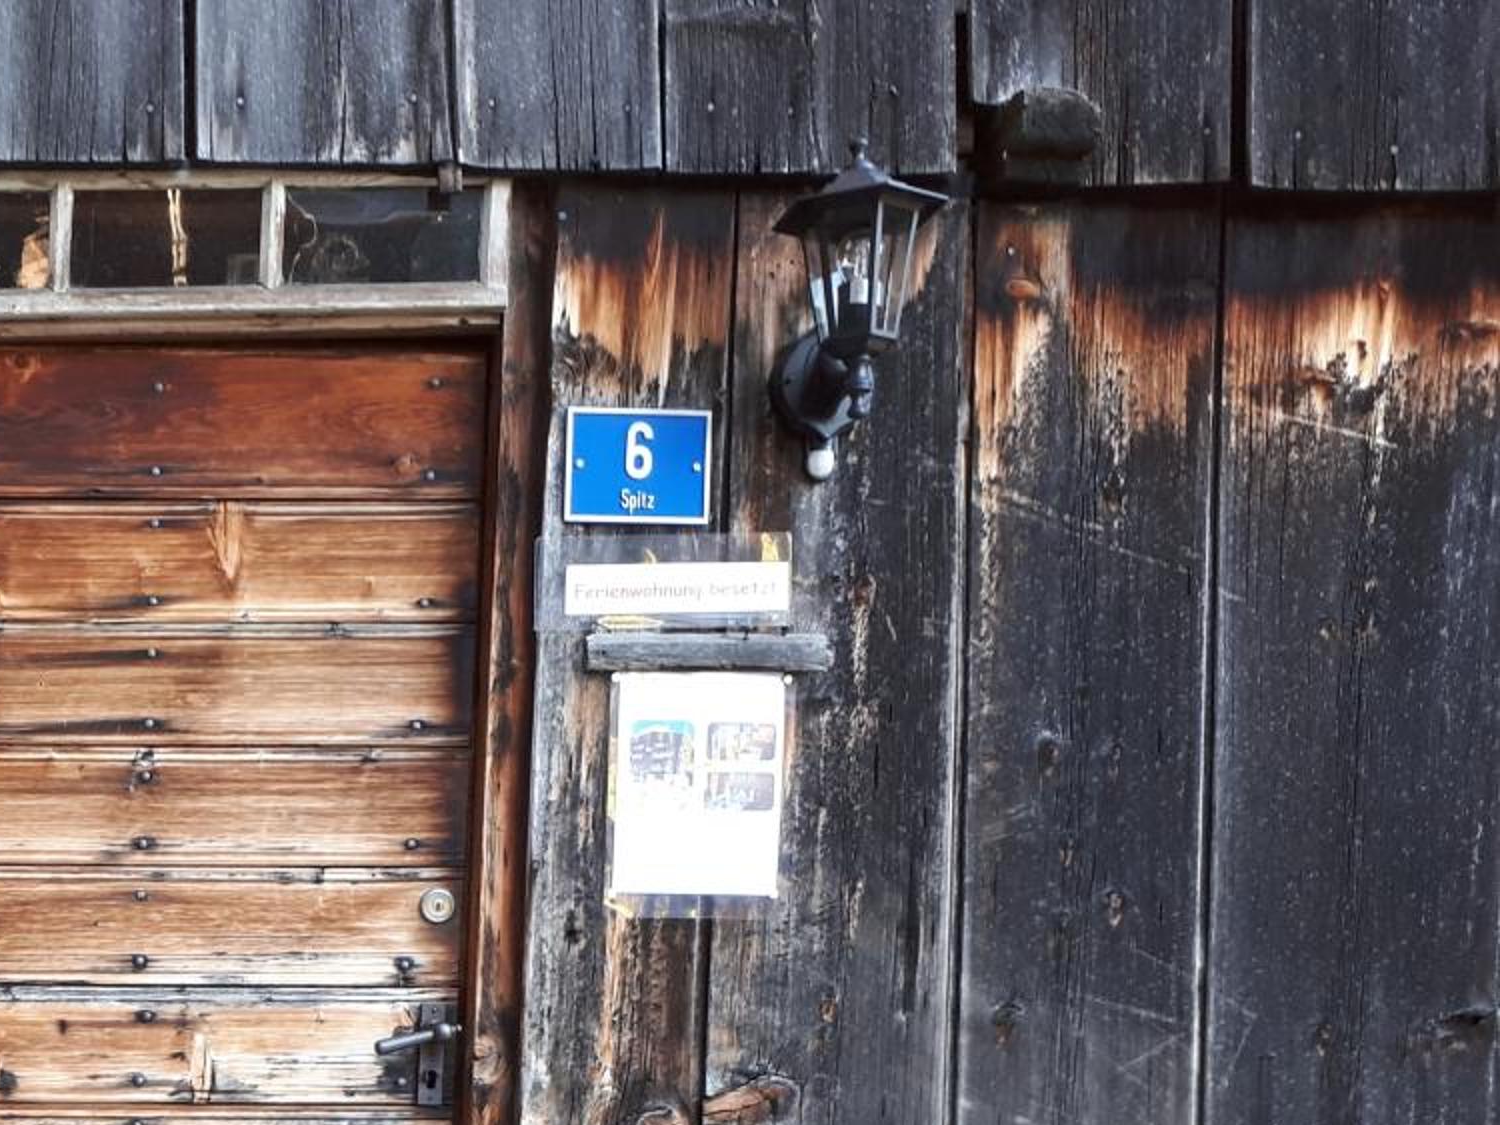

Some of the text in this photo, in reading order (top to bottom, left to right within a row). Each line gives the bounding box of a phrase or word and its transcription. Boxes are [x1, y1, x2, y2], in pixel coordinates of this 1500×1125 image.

[625, 421, 654, 480] 6
[620, 488, 655, 515] Spitz
[574, 582, 702, 600] Ferienwohnung
